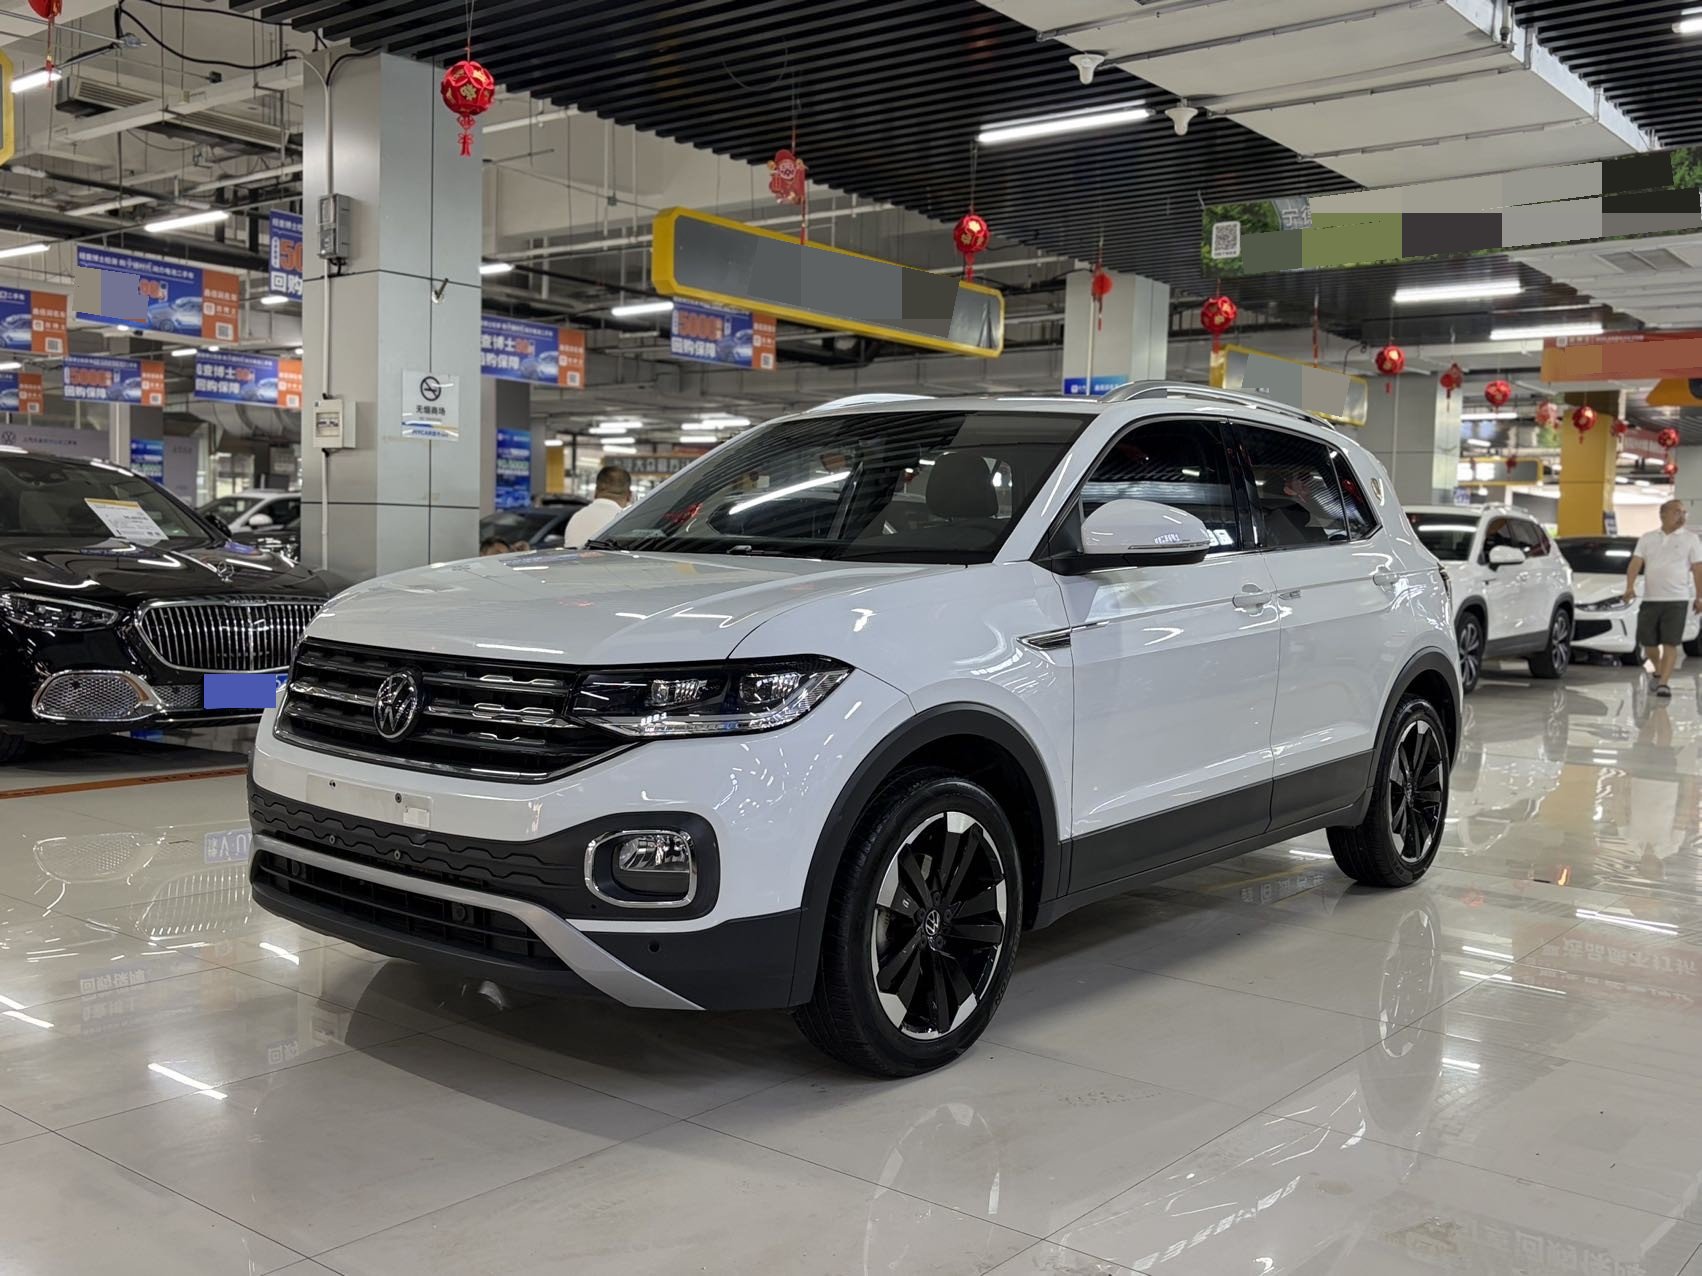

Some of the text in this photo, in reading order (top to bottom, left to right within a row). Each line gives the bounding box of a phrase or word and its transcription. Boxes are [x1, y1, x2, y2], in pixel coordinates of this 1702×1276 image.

[671, 336, 716, 358] 回购保障
[195, 378, 240, 394] 回购保障
[415, 405, 446, 416] 无烟商场
